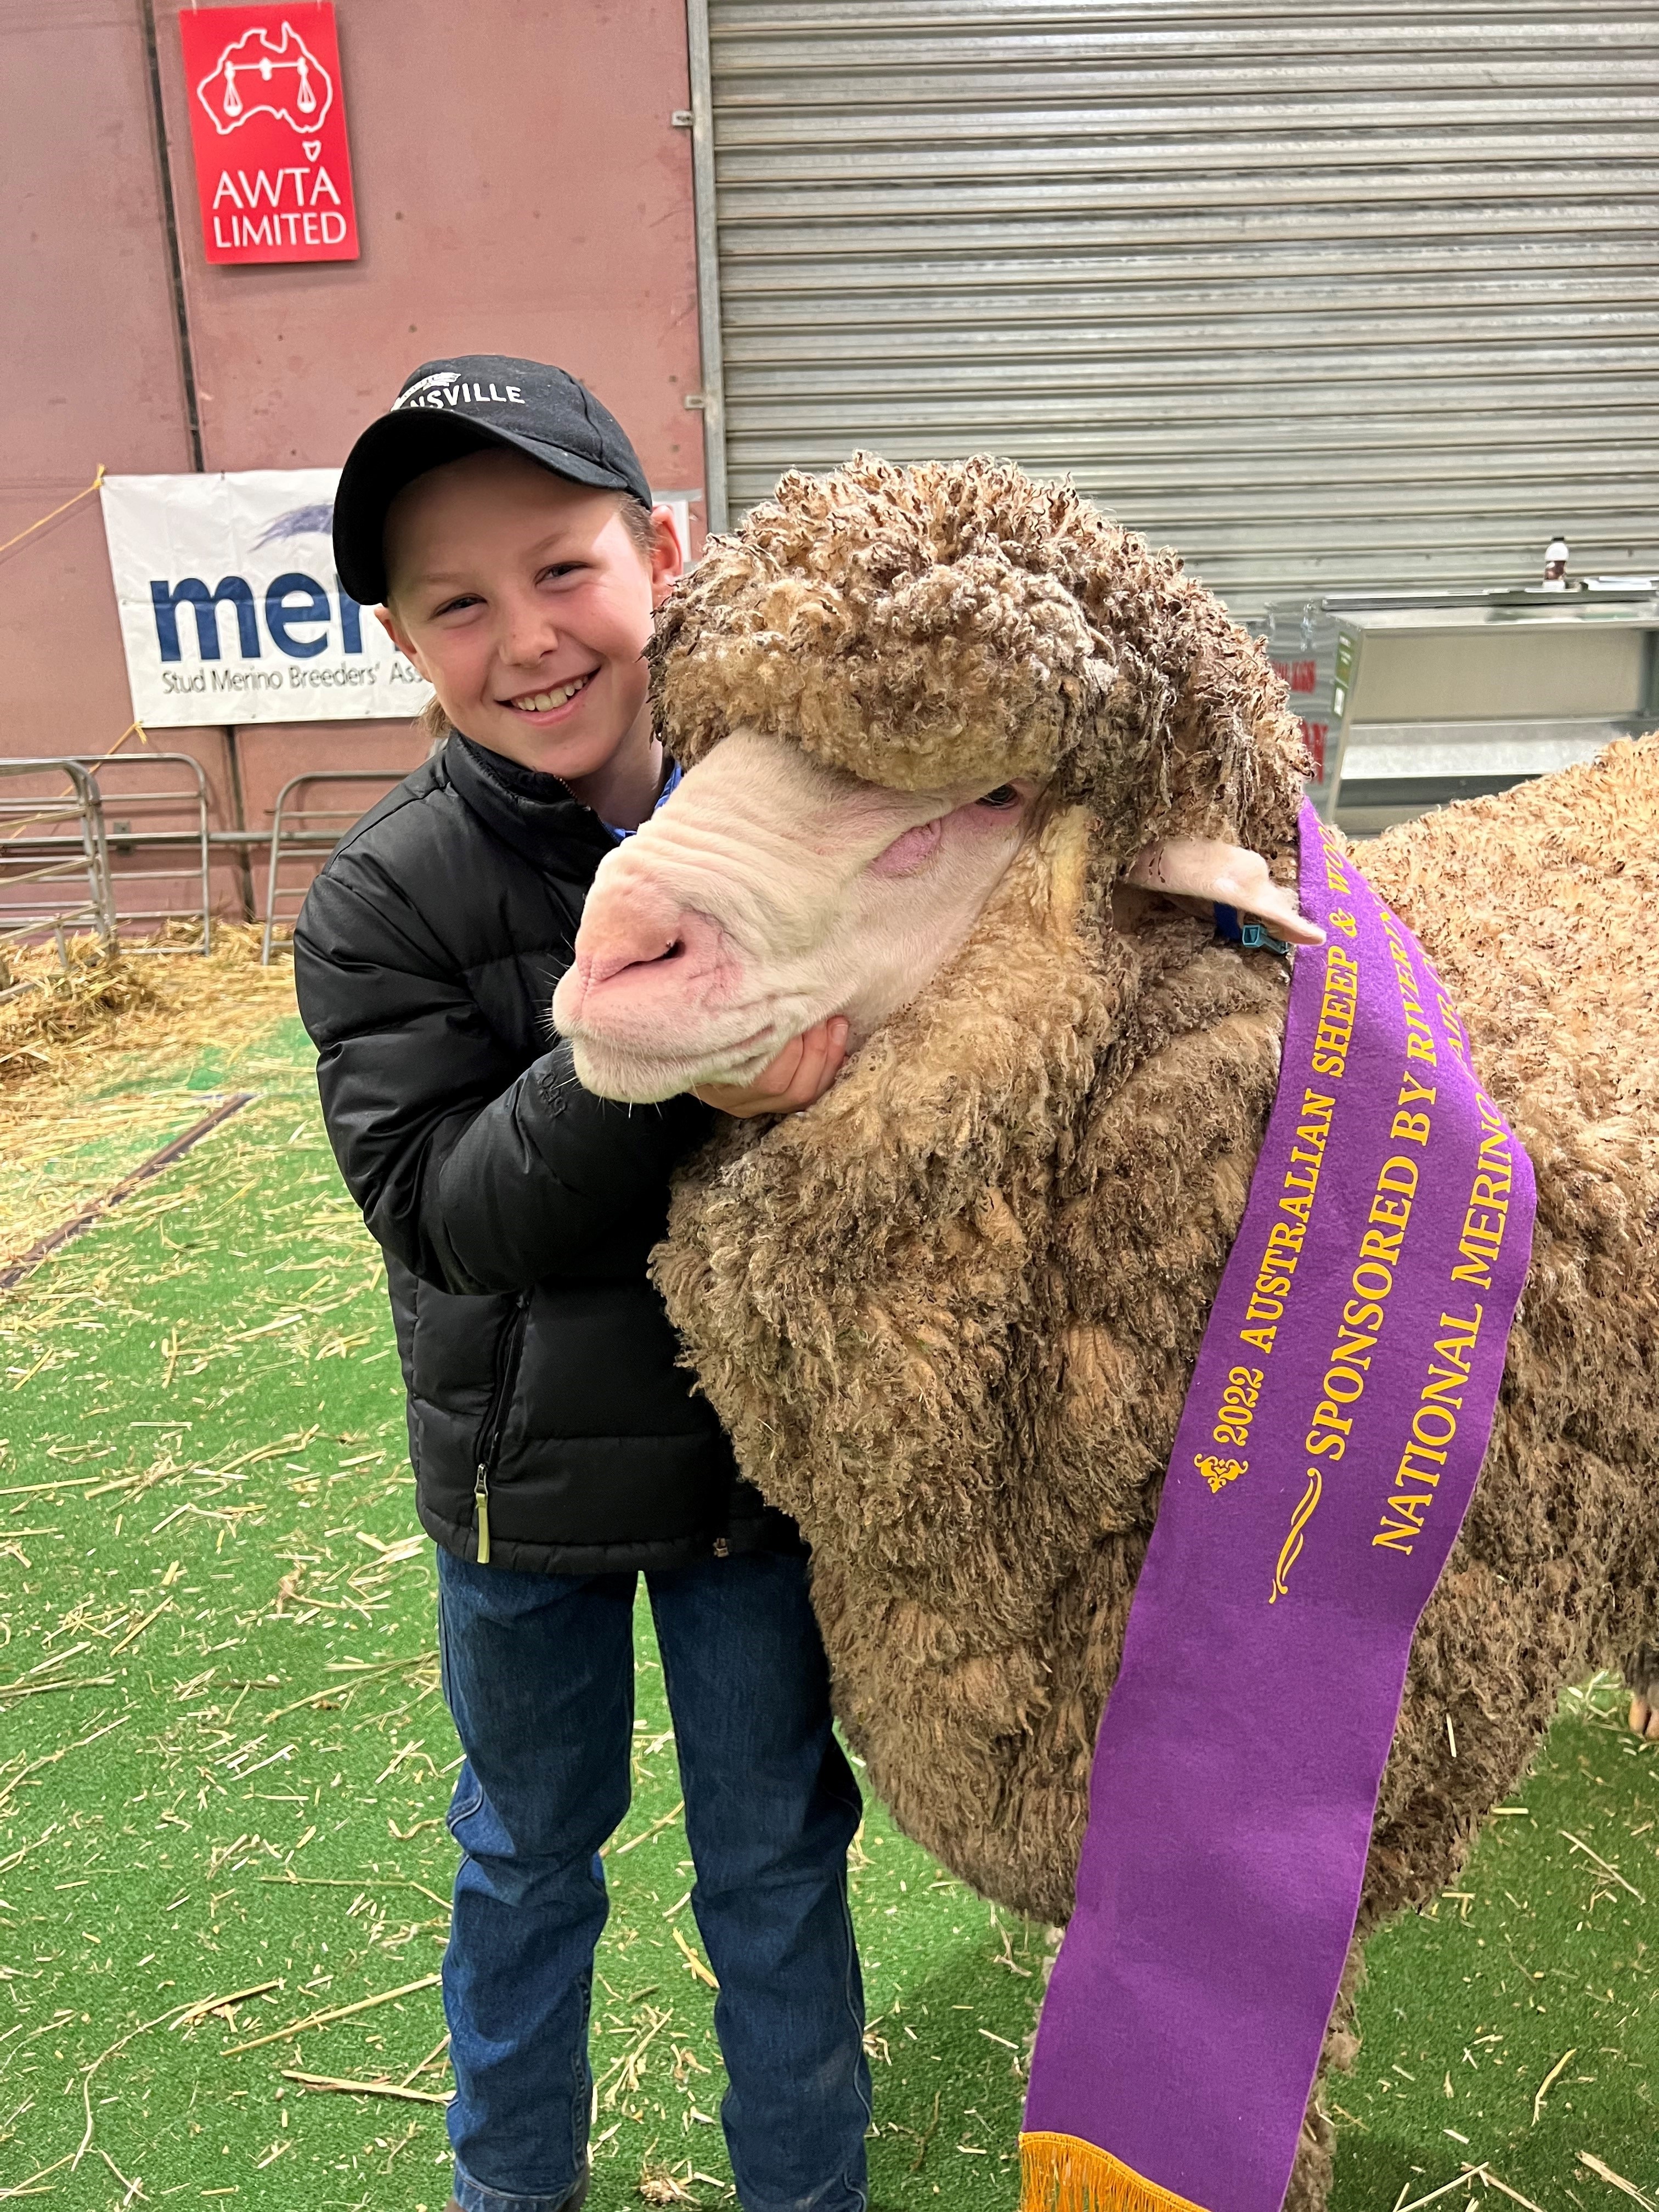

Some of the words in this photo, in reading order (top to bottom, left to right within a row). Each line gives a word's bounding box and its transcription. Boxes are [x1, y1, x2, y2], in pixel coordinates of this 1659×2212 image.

[212, 166, 341, 210] AWTA
[213, 211, 347, 248] LIMITED
[410, 383, 526, 409] NSVILLE
[149, 572, 403, 662] mer
[162, 667, 206, 694] Stud
[211, 665, 284, 693] Merino
[389, 661, 423, 685] Ass
[1313, 812, 1352, 895] WOO
[1329, 907, 1357, 938] &
[1311, 946, 1358, 1078] SHEEP
[1368, 885, 1437, 1067] RIVERIN
[1390, 1071, 1436, 1146] BY
[1239, 1088, 1336, 1354] AUSTRALIAN
[1305, 1156, 1419, 1461] SPONSORED
[1372, 1304, 1483, 1555] NATIONAL
[1451, 1092, 1512, 1290] MERINO
[1212, 1366, 1265, 1447] 2022
